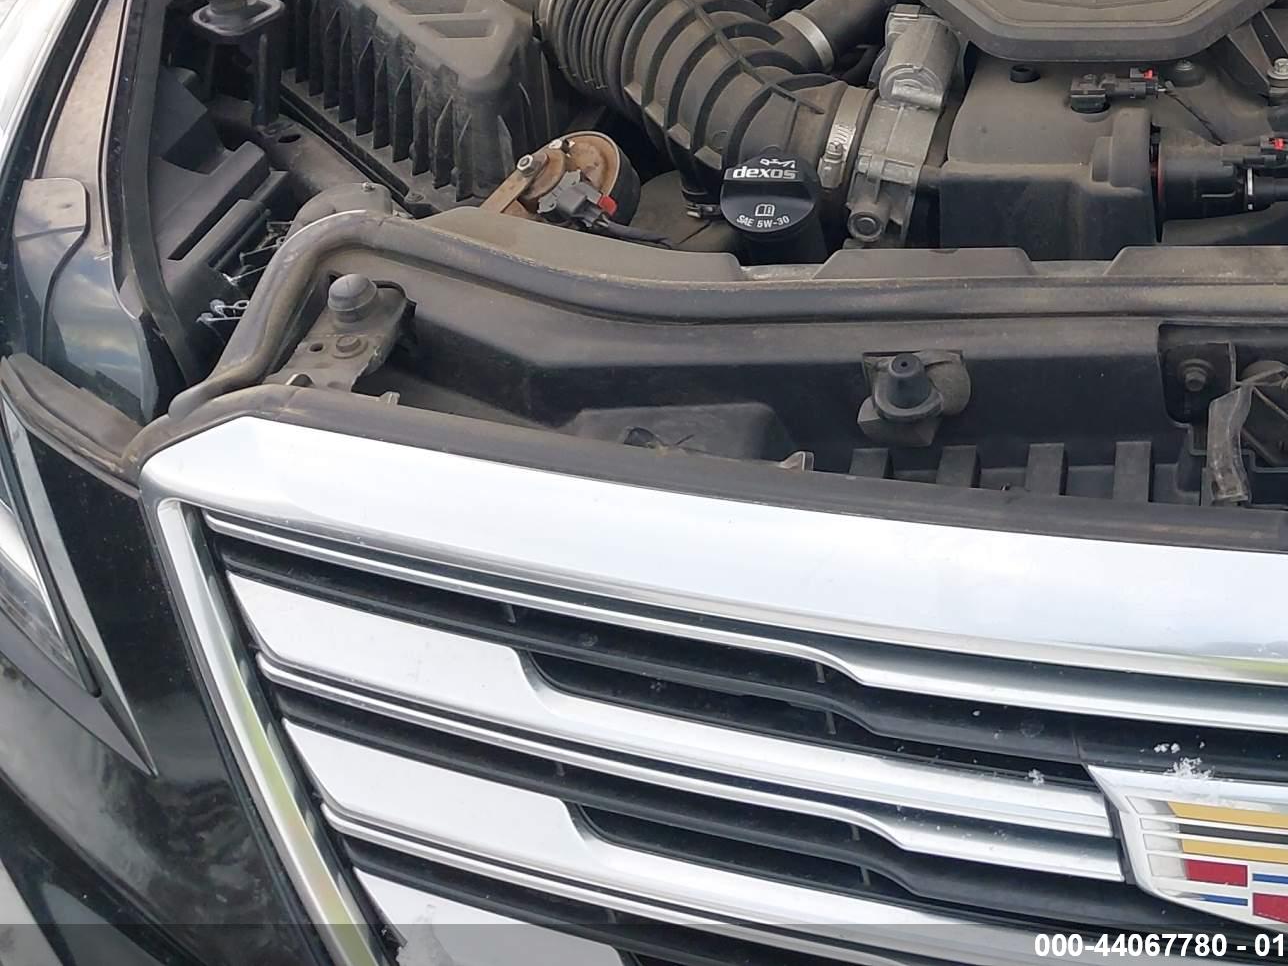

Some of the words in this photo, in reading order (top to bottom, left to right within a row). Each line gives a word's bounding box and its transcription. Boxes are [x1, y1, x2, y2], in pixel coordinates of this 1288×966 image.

[732, 166, 799, 180] dexos
[736, 215, 755, 227] SAE
[757, 215, 790, 228] 5W-30
